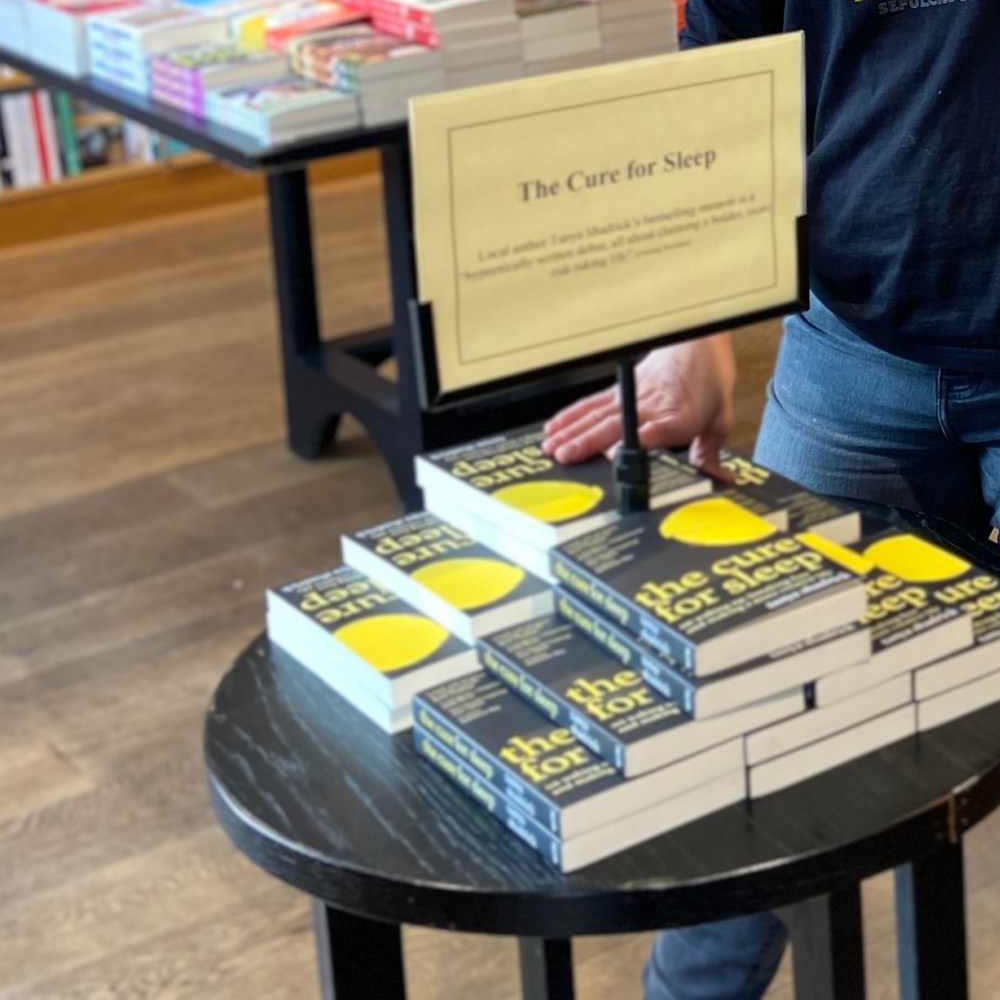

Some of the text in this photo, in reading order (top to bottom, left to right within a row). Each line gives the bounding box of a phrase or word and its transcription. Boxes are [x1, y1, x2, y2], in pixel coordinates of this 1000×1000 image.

[516, 146, 718, 203] The Cure for Sleep
[477, 244, 510, 263] Local
[470, 457, 554, 489] cure
[634, 537, 803, 609] the cure
[655, 550, 823, 624] for sleep
[564, 669, 643, 704] the
[586, 687, 654, 722] for
[499, 727, 577, 765] the
[519, 746, 591, 784] for
